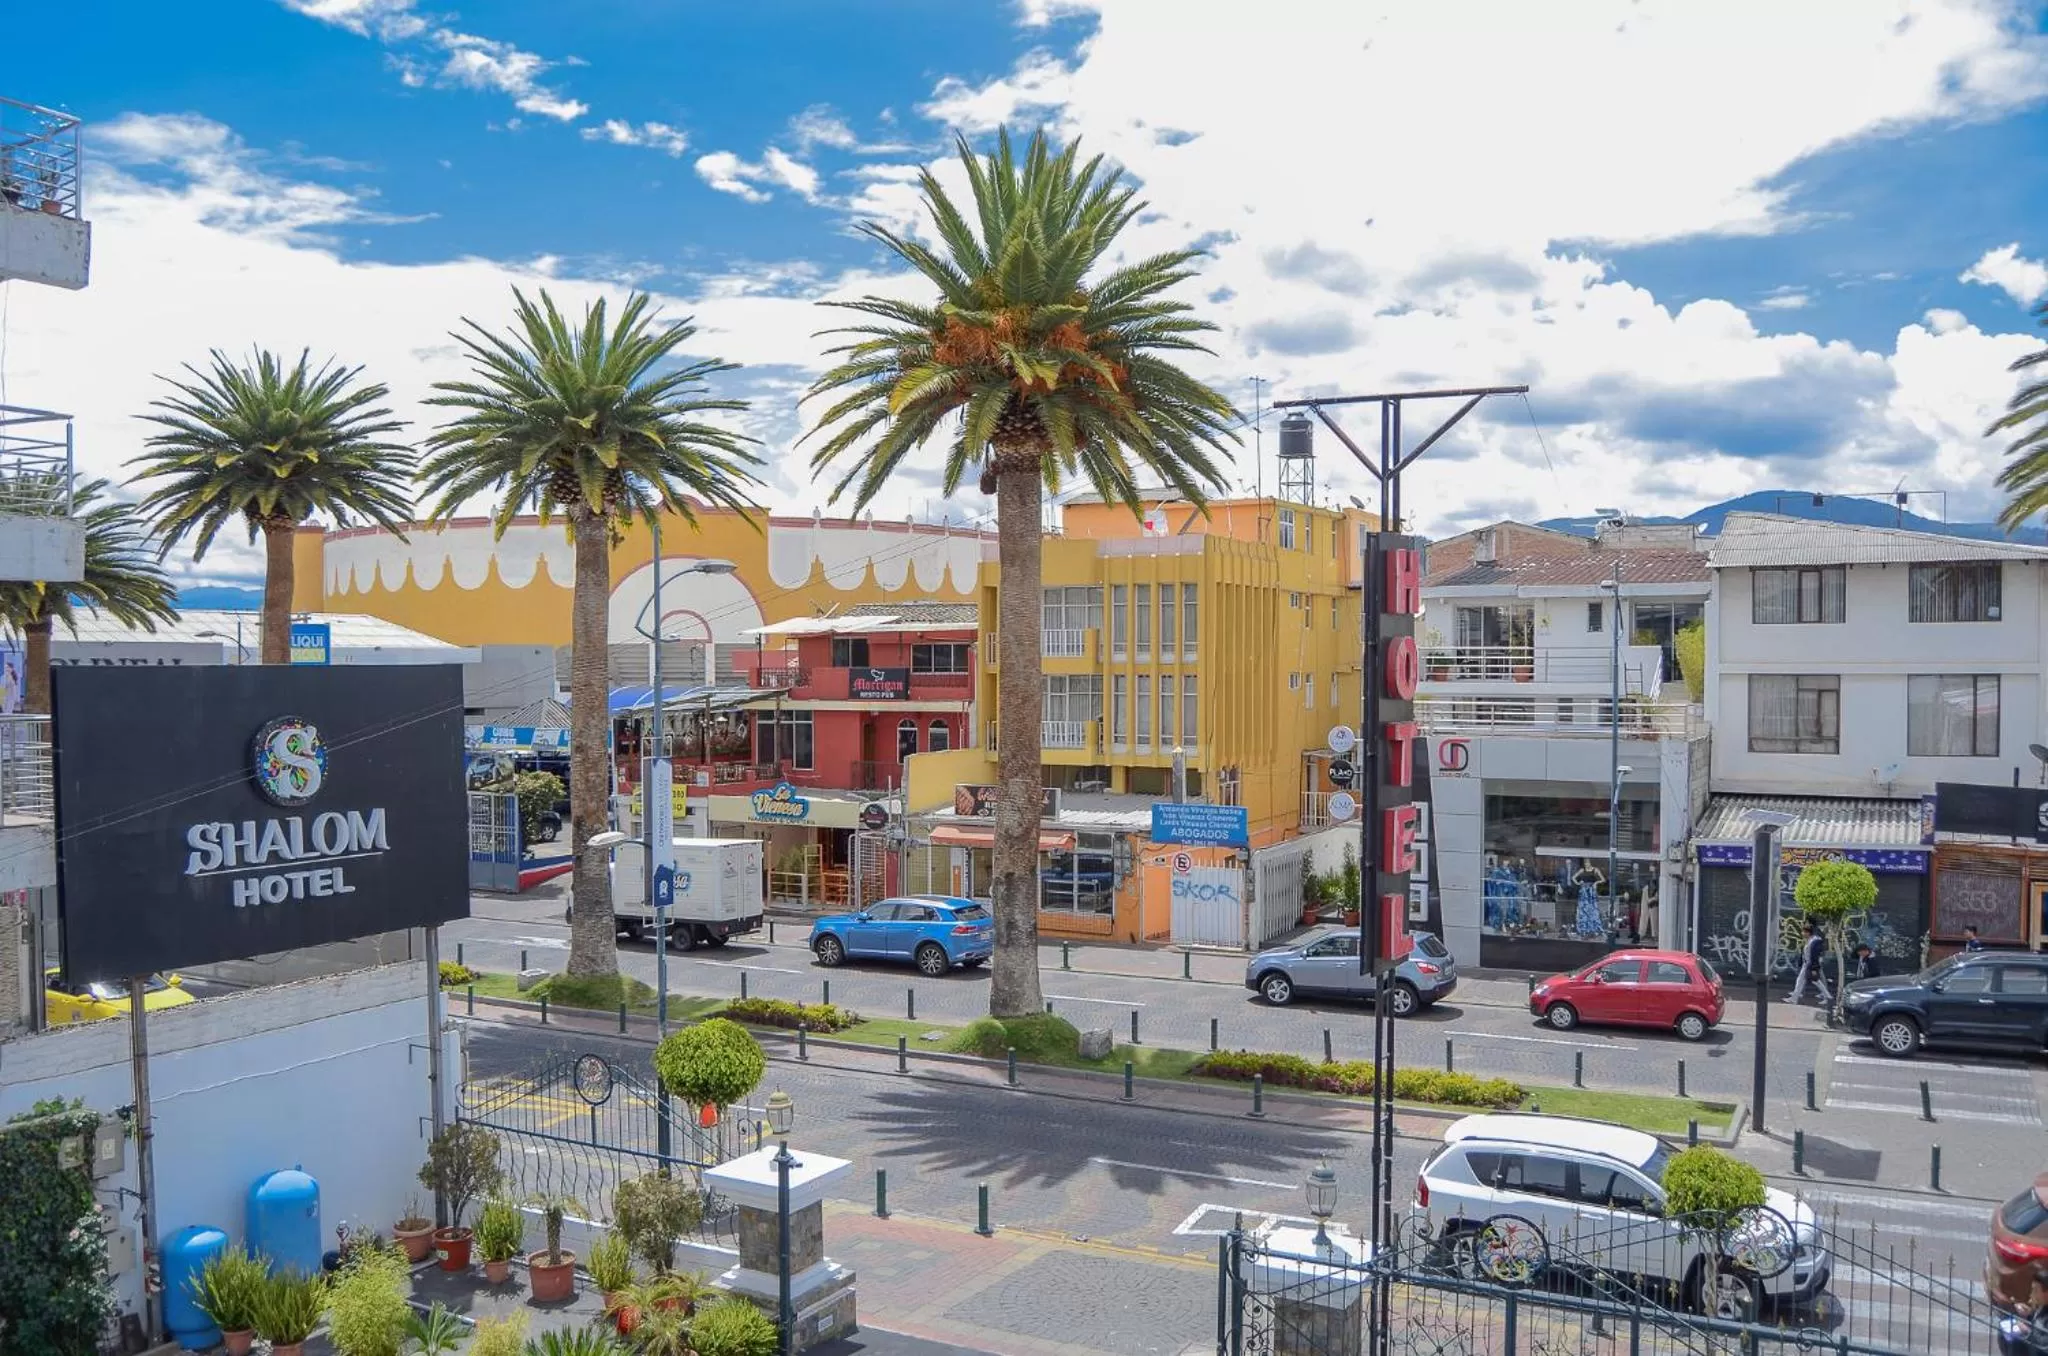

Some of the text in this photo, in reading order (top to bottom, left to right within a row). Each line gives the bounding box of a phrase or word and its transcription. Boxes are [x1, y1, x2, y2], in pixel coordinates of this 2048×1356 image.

[290, 635, 324, 648] LIQUI
[853, 678, 904, 691] Morrigan
[1384, 549, 1420, 961] HOTEL
[754, 794, 803, 817] Vienesa
[184, 807, 391, 875] SHALOM
[1171, 828, 1229, 840] ABOGADOS
[233, 867, 356, 907] HOTEL
[1172, 879, 1240, 903] SKOR
